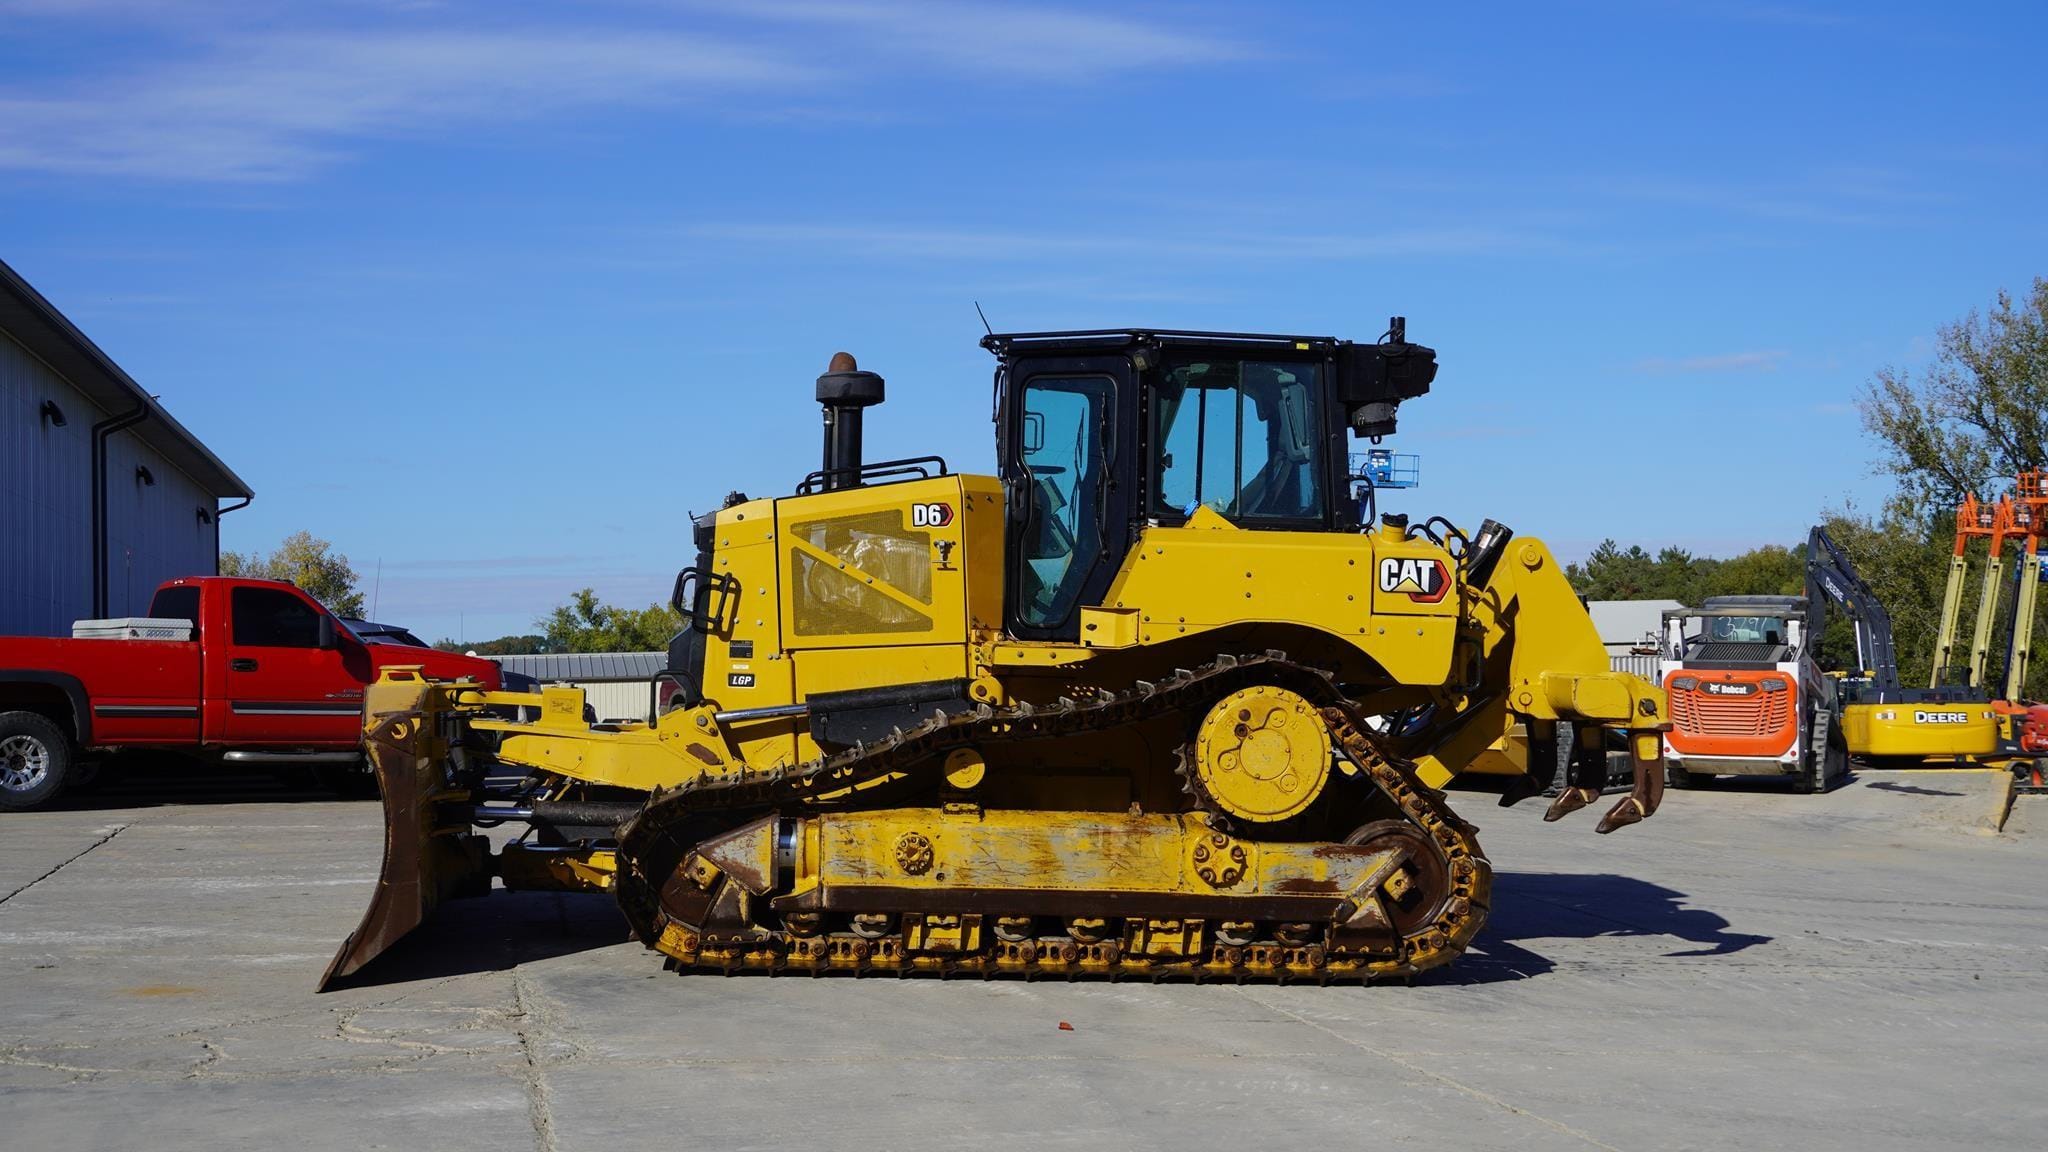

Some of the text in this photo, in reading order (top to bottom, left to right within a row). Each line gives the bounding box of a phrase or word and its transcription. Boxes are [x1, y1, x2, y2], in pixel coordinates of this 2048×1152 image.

[913, 504, 942, 526] D6
[1380, 558, 1435, 593] CAT
[1825, 576, 1844, 602] DEERE
[732, 675, 752, 685] LGP
[1721, 685, 1747, 694] Bobcat
[1914, 711, 1968, 723] DEERE
